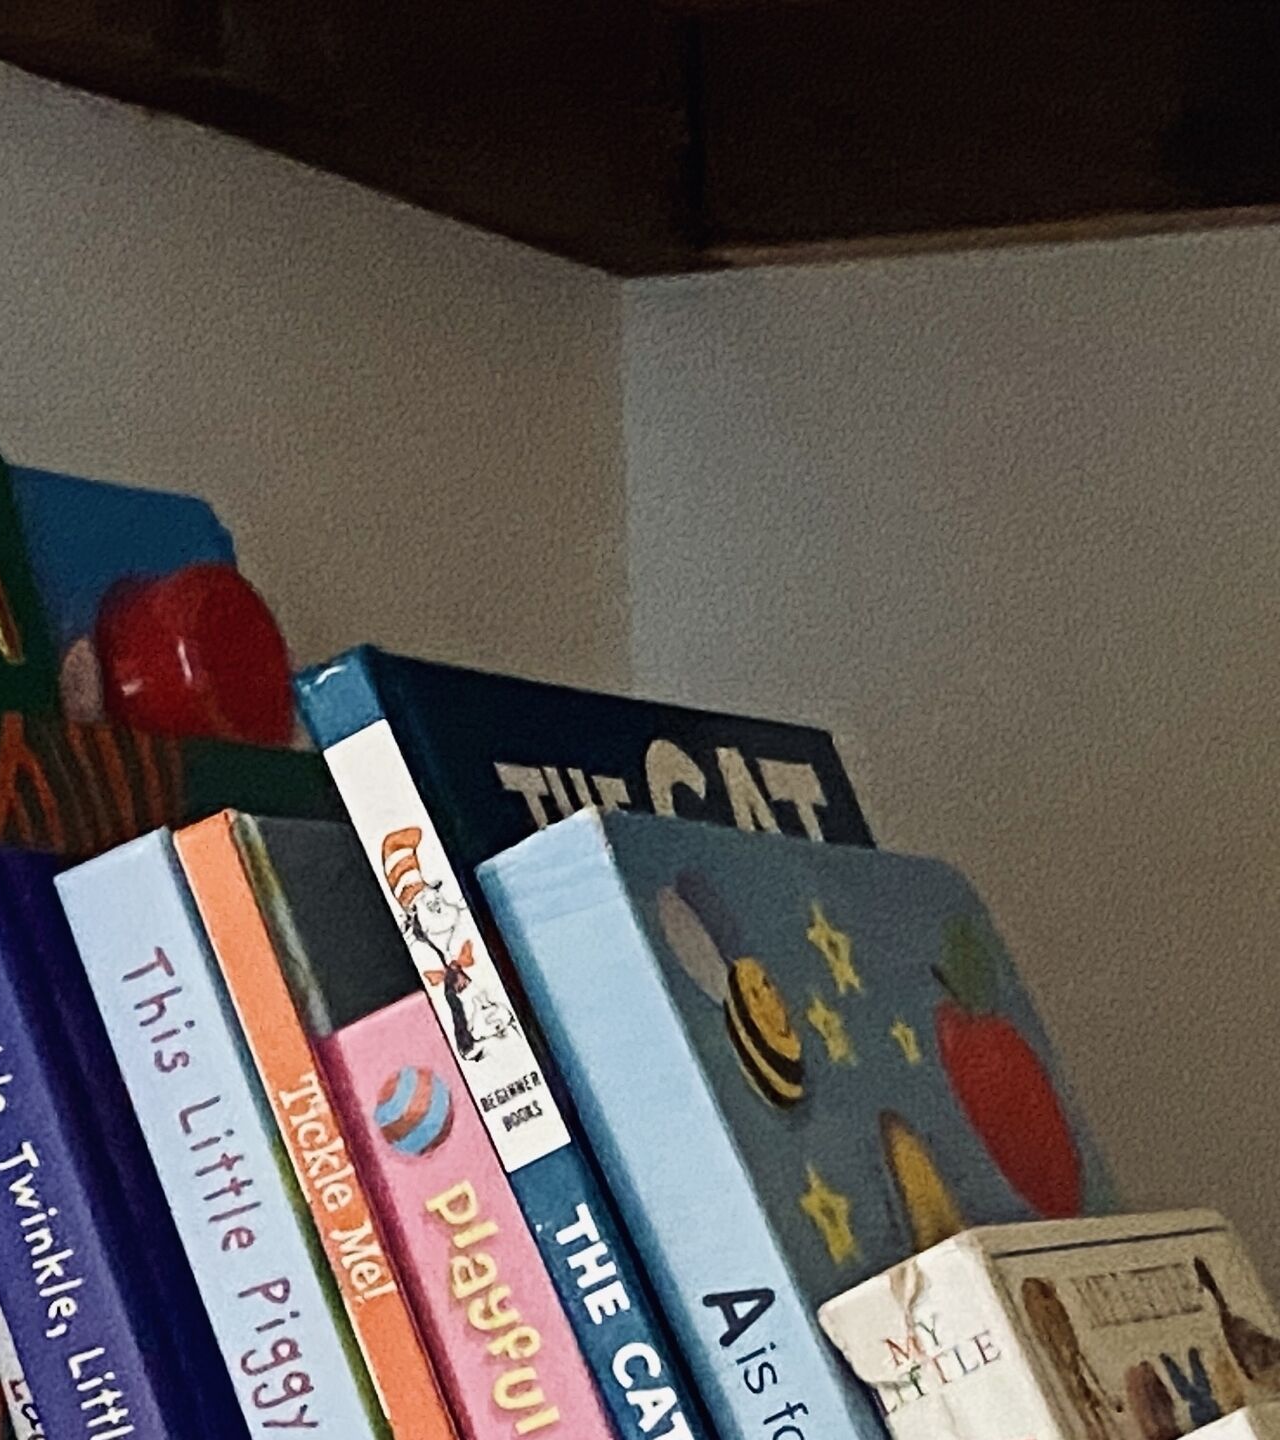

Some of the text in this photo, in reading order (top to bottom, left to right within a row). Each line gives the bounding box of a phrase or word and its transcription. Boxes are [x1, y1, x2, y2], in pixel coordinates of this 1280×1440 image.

[122, 946, 319, 1430] This Little Piggy
[278, 1071, 400, 1305] Tickle Me!
[554, 1202, 632, 1326] THE
[702, 1287, 776, 1348] A
[883, 1312, 940, 1369] MY
[736, 1342, 778, 1395] is
